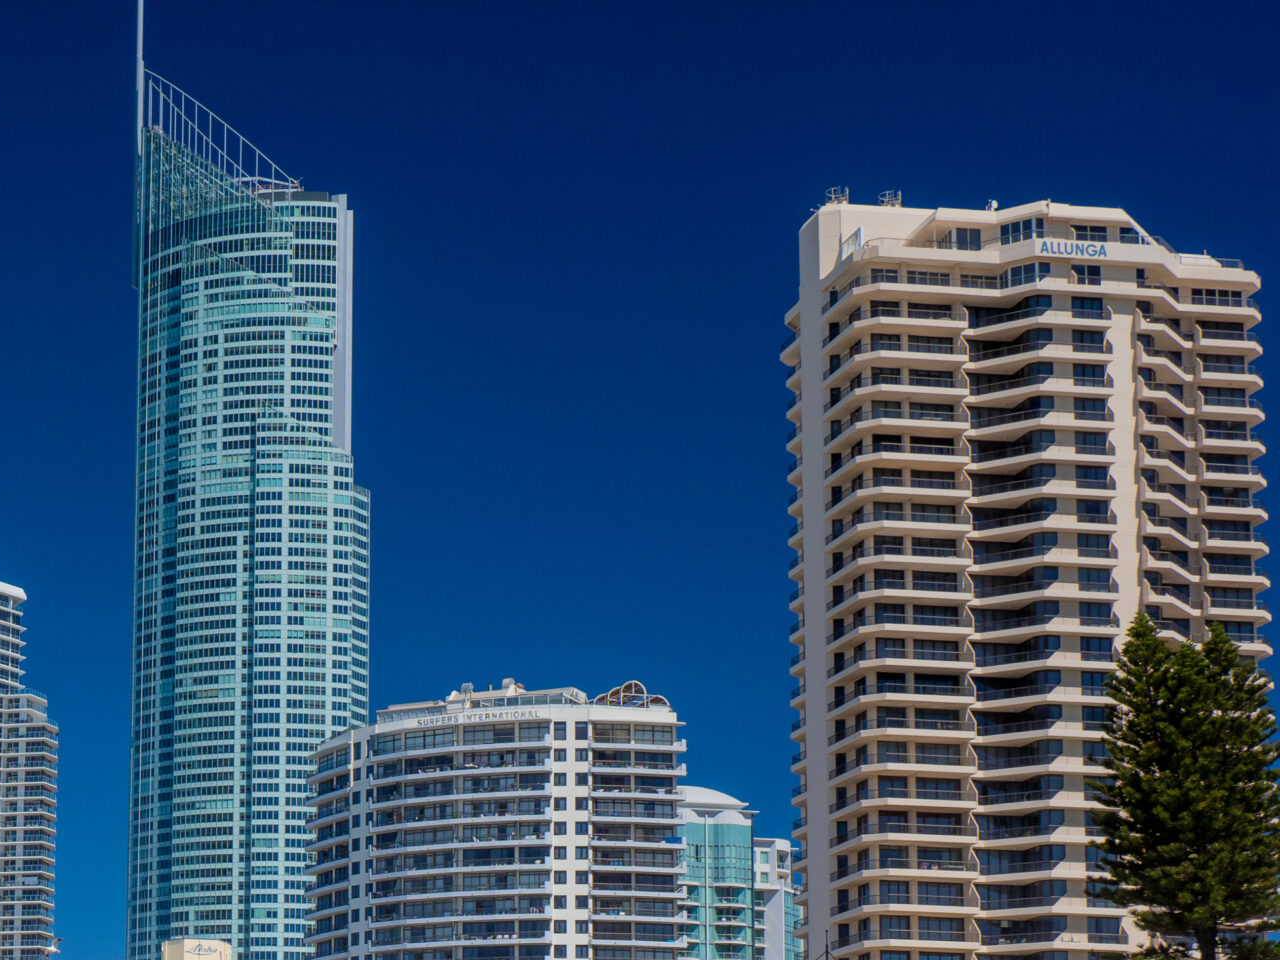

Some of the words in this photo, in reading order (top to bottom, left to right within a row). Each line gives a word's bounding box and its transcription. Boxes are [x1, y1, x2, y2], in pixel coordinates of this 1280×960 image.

[1040, 241, 1107, 257] ALLUNGA
[417, 715, 459, 727] SURFERS
[463, 710, 540, 721] INTERNATIONAL
